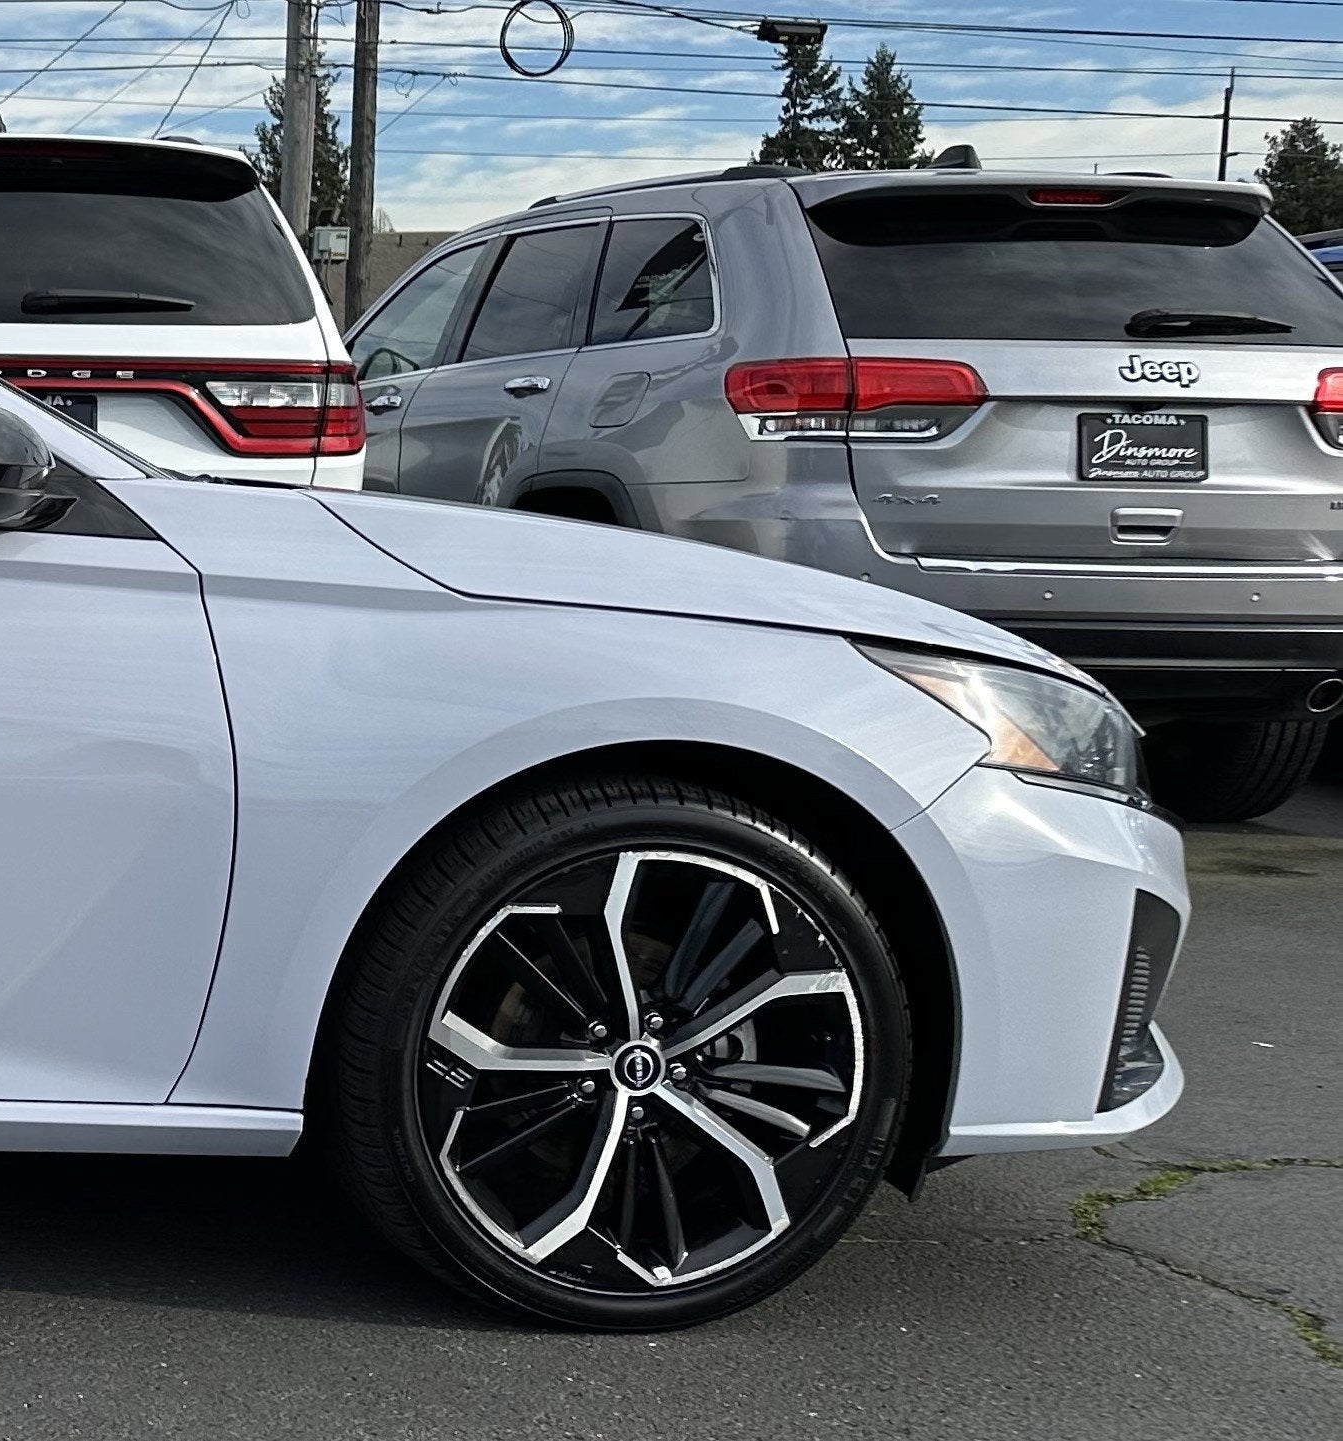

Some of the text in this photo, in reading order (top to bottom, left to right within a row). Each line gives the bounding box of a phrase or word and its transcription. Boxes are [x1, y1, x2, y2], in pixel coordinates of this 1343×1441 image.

[1119, 354, 1201, 388] Jeep
[1111, 413, 1178, 425] TACOMA
[1091, 429, 1200, 464] Dinsmore
[1141, 469, 1169, 478] AUTO
[1169, 470, 1206, 479] GROUP
